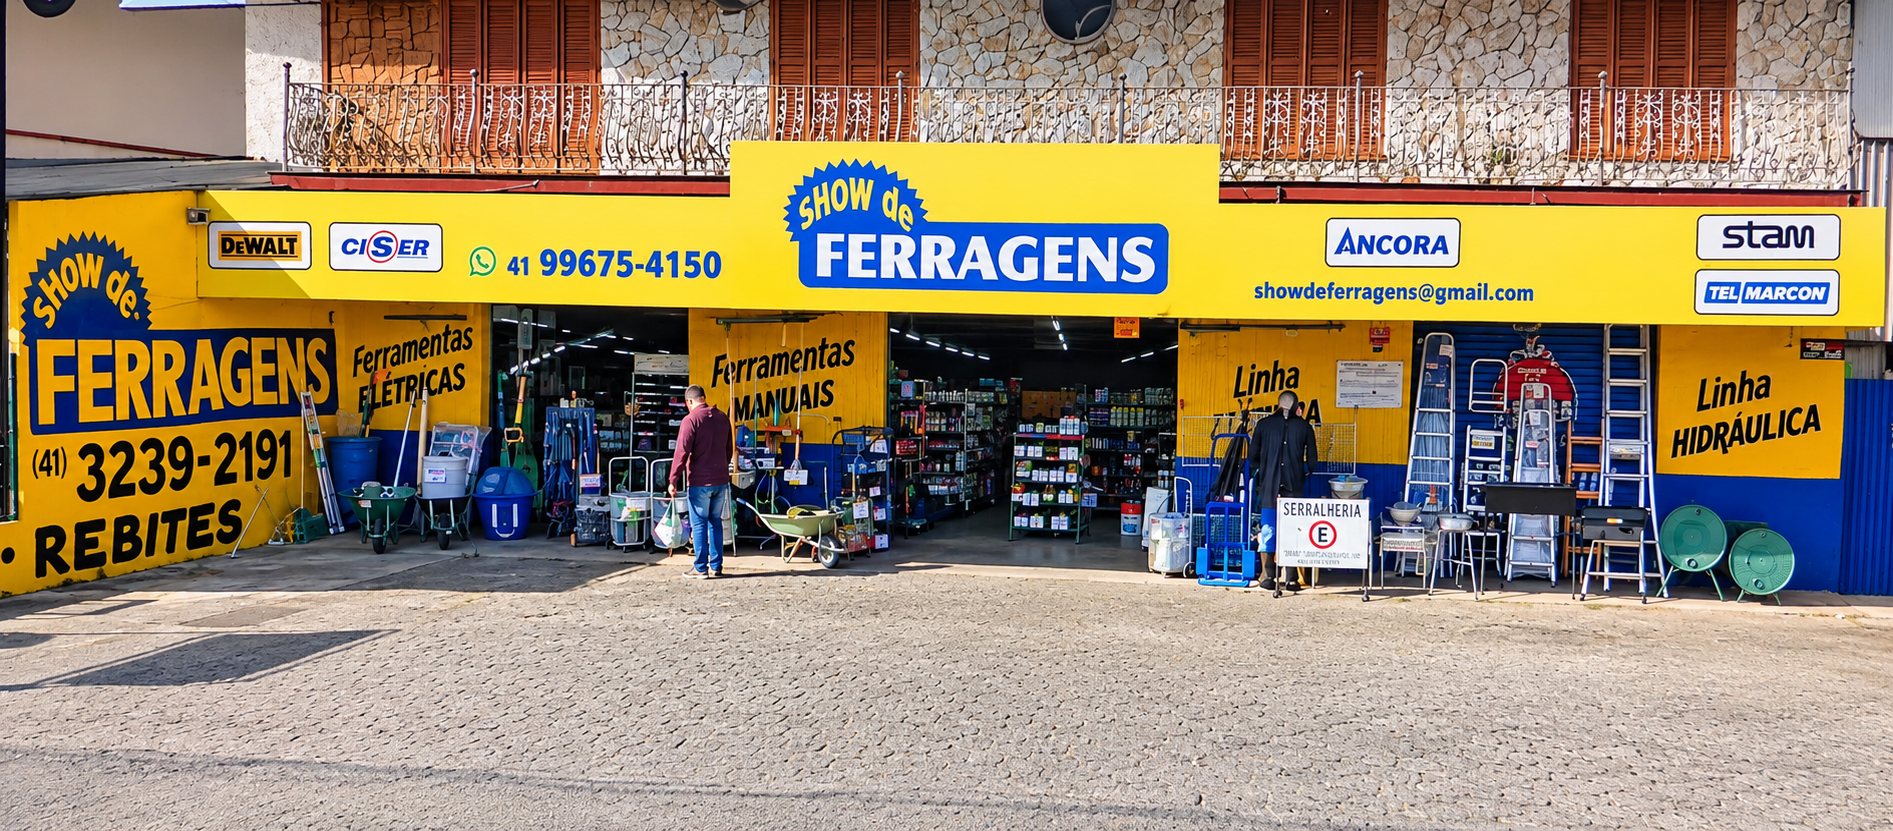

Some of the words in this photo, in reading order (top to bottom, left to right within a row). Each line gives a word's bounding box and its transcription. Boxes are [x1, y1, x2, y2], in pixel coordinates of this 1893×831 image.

[801, 177, 873, 229] SHOW
[883, 184, 914, 231] de
[341, 234, 430, 263] CISER
[816, 232, 1155, 283] FERRAGENS
[1722, 220, 1815, 250] stam
[507, 256, 530, 276] 41
[540, 248, 722, 279] 99675-4150
[32, 252, 105, 330] SHOW
[1254, 281, 1535, 305] showdeferragens@gmail.com
[1708, 285, 1738, 301] TEL
[1744, 285, 1827, 302] MARCON
[352, 323, 474, 378] Ferramentas
[711, 337, 856, 389] Ferramentas
[36, 335, 331, 426] FERRAGENS
[357, 362, 466, 414] ELÉTRICAS
[729, 379, 836, 424] MANUAIS
[1233, 359, 1300, 399] Linha
[1696, 369, 1771, 412] Linha
[1671, 401, 1821, 460] HIDRÁULICA
[31, 445, 69, 481] (41)
[75, 428, 293, 504] 3239-2191
[1283, 502, 1362, 518] SERRALHERIA
[34, 498, 243, 578] REBITES
[1318, 527, 1328, 543] E
